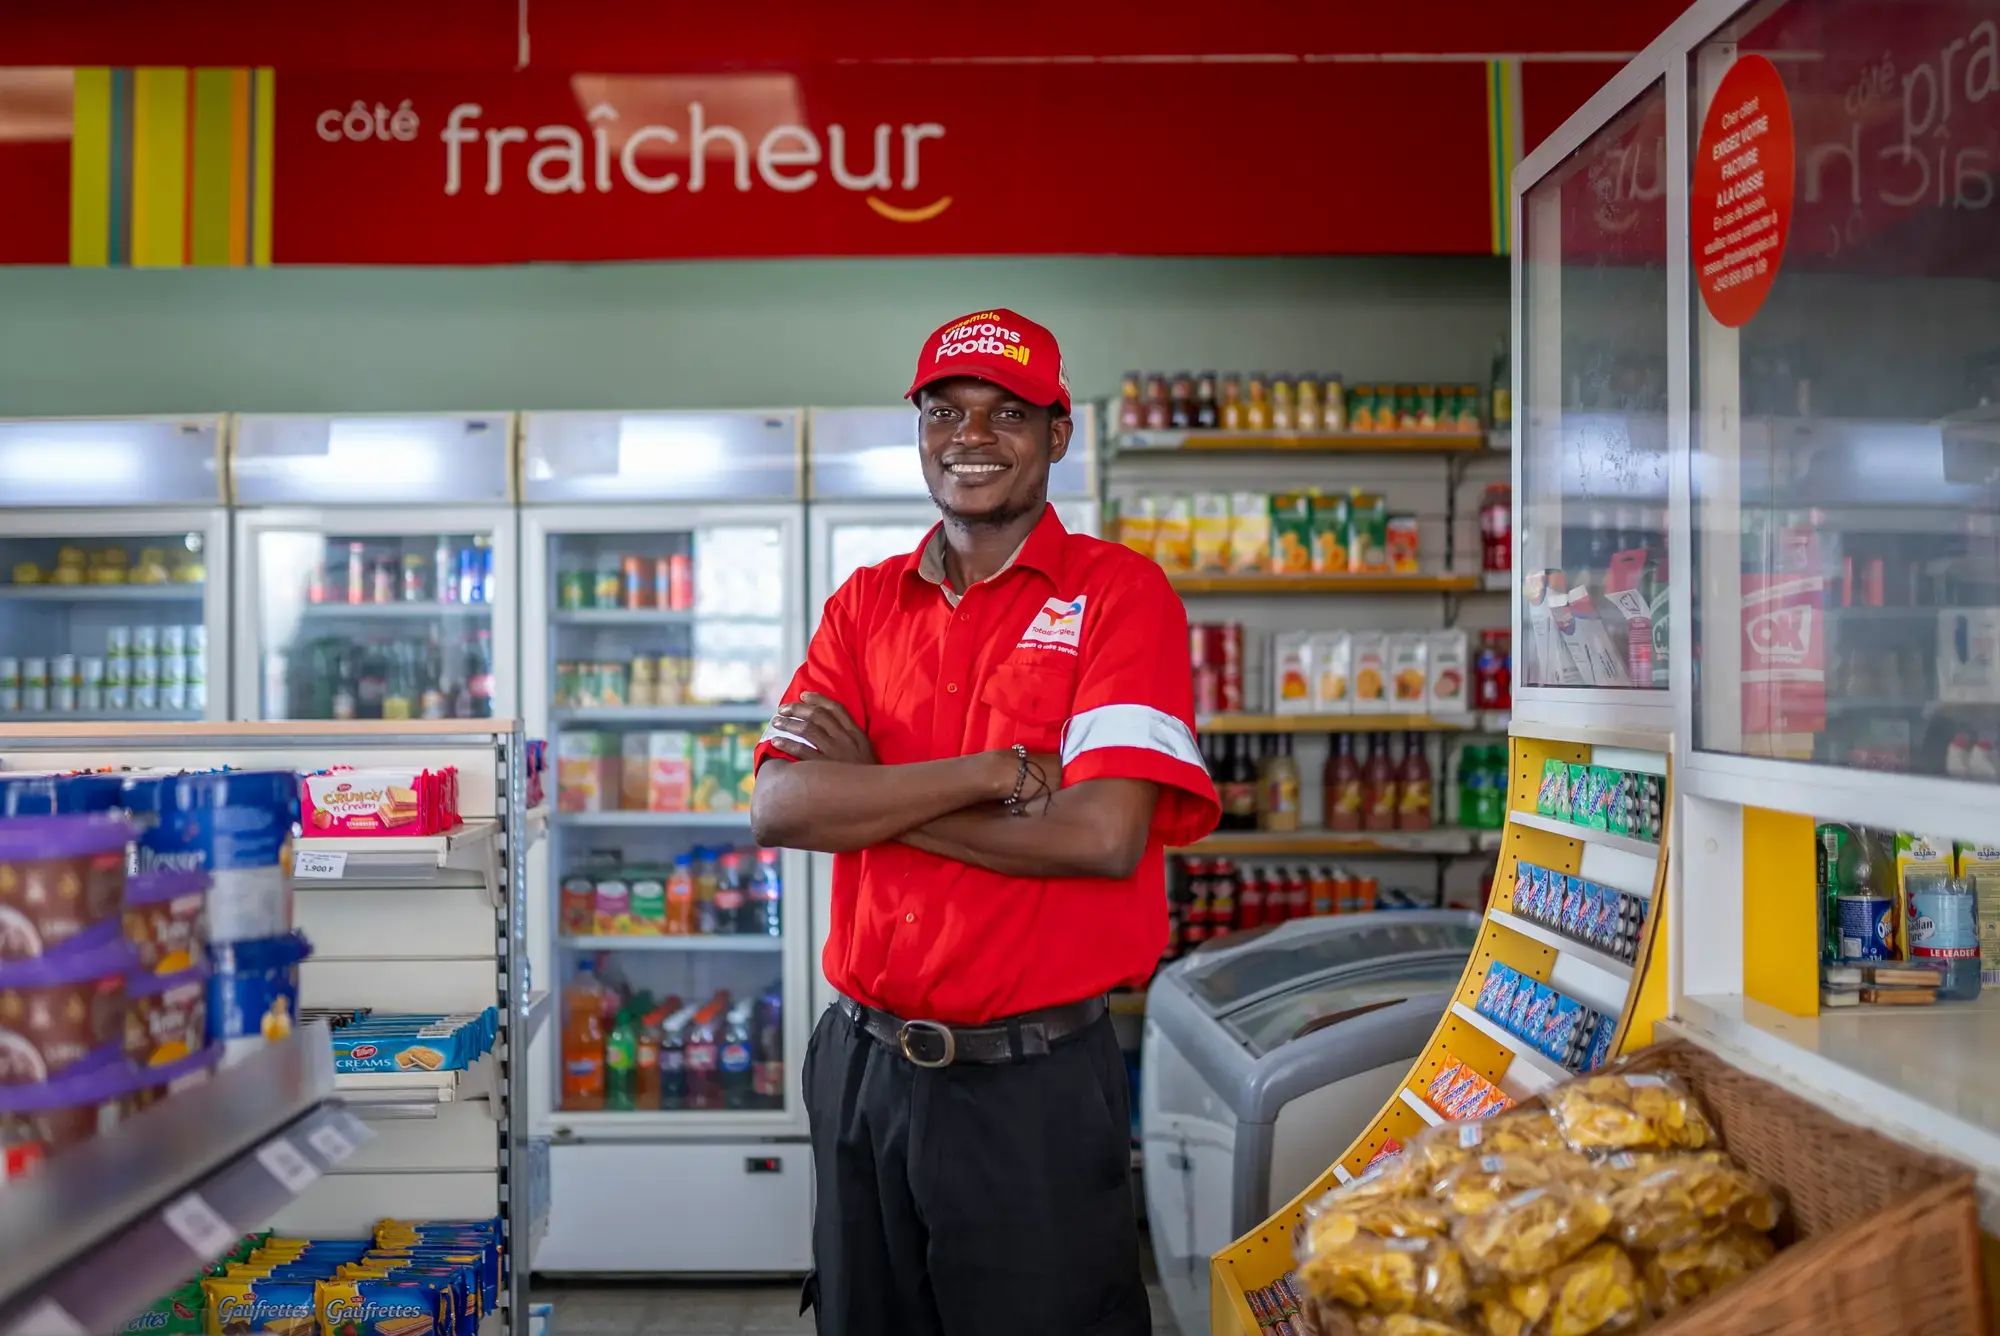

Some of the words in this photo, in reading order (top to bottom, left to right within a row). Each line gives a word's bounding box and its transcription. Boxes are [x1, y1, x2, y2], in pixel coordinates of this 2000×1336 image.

[316, 100, 420, 142] côté
[442, 102, 946, 194] fraîcheur
[941, 323, 1021, 344] Vibrons
[935, 336, 1031, 366] Football
[1930, 949, 1940, 957] LE
[1943, 949, 1975, 958] LEADER
[336, 1059, 391, 1067] CREAMS
[219, 1296, 309, 1324] Gaufrettes
[326, 1299, 421, 1325] Gaufrettes
